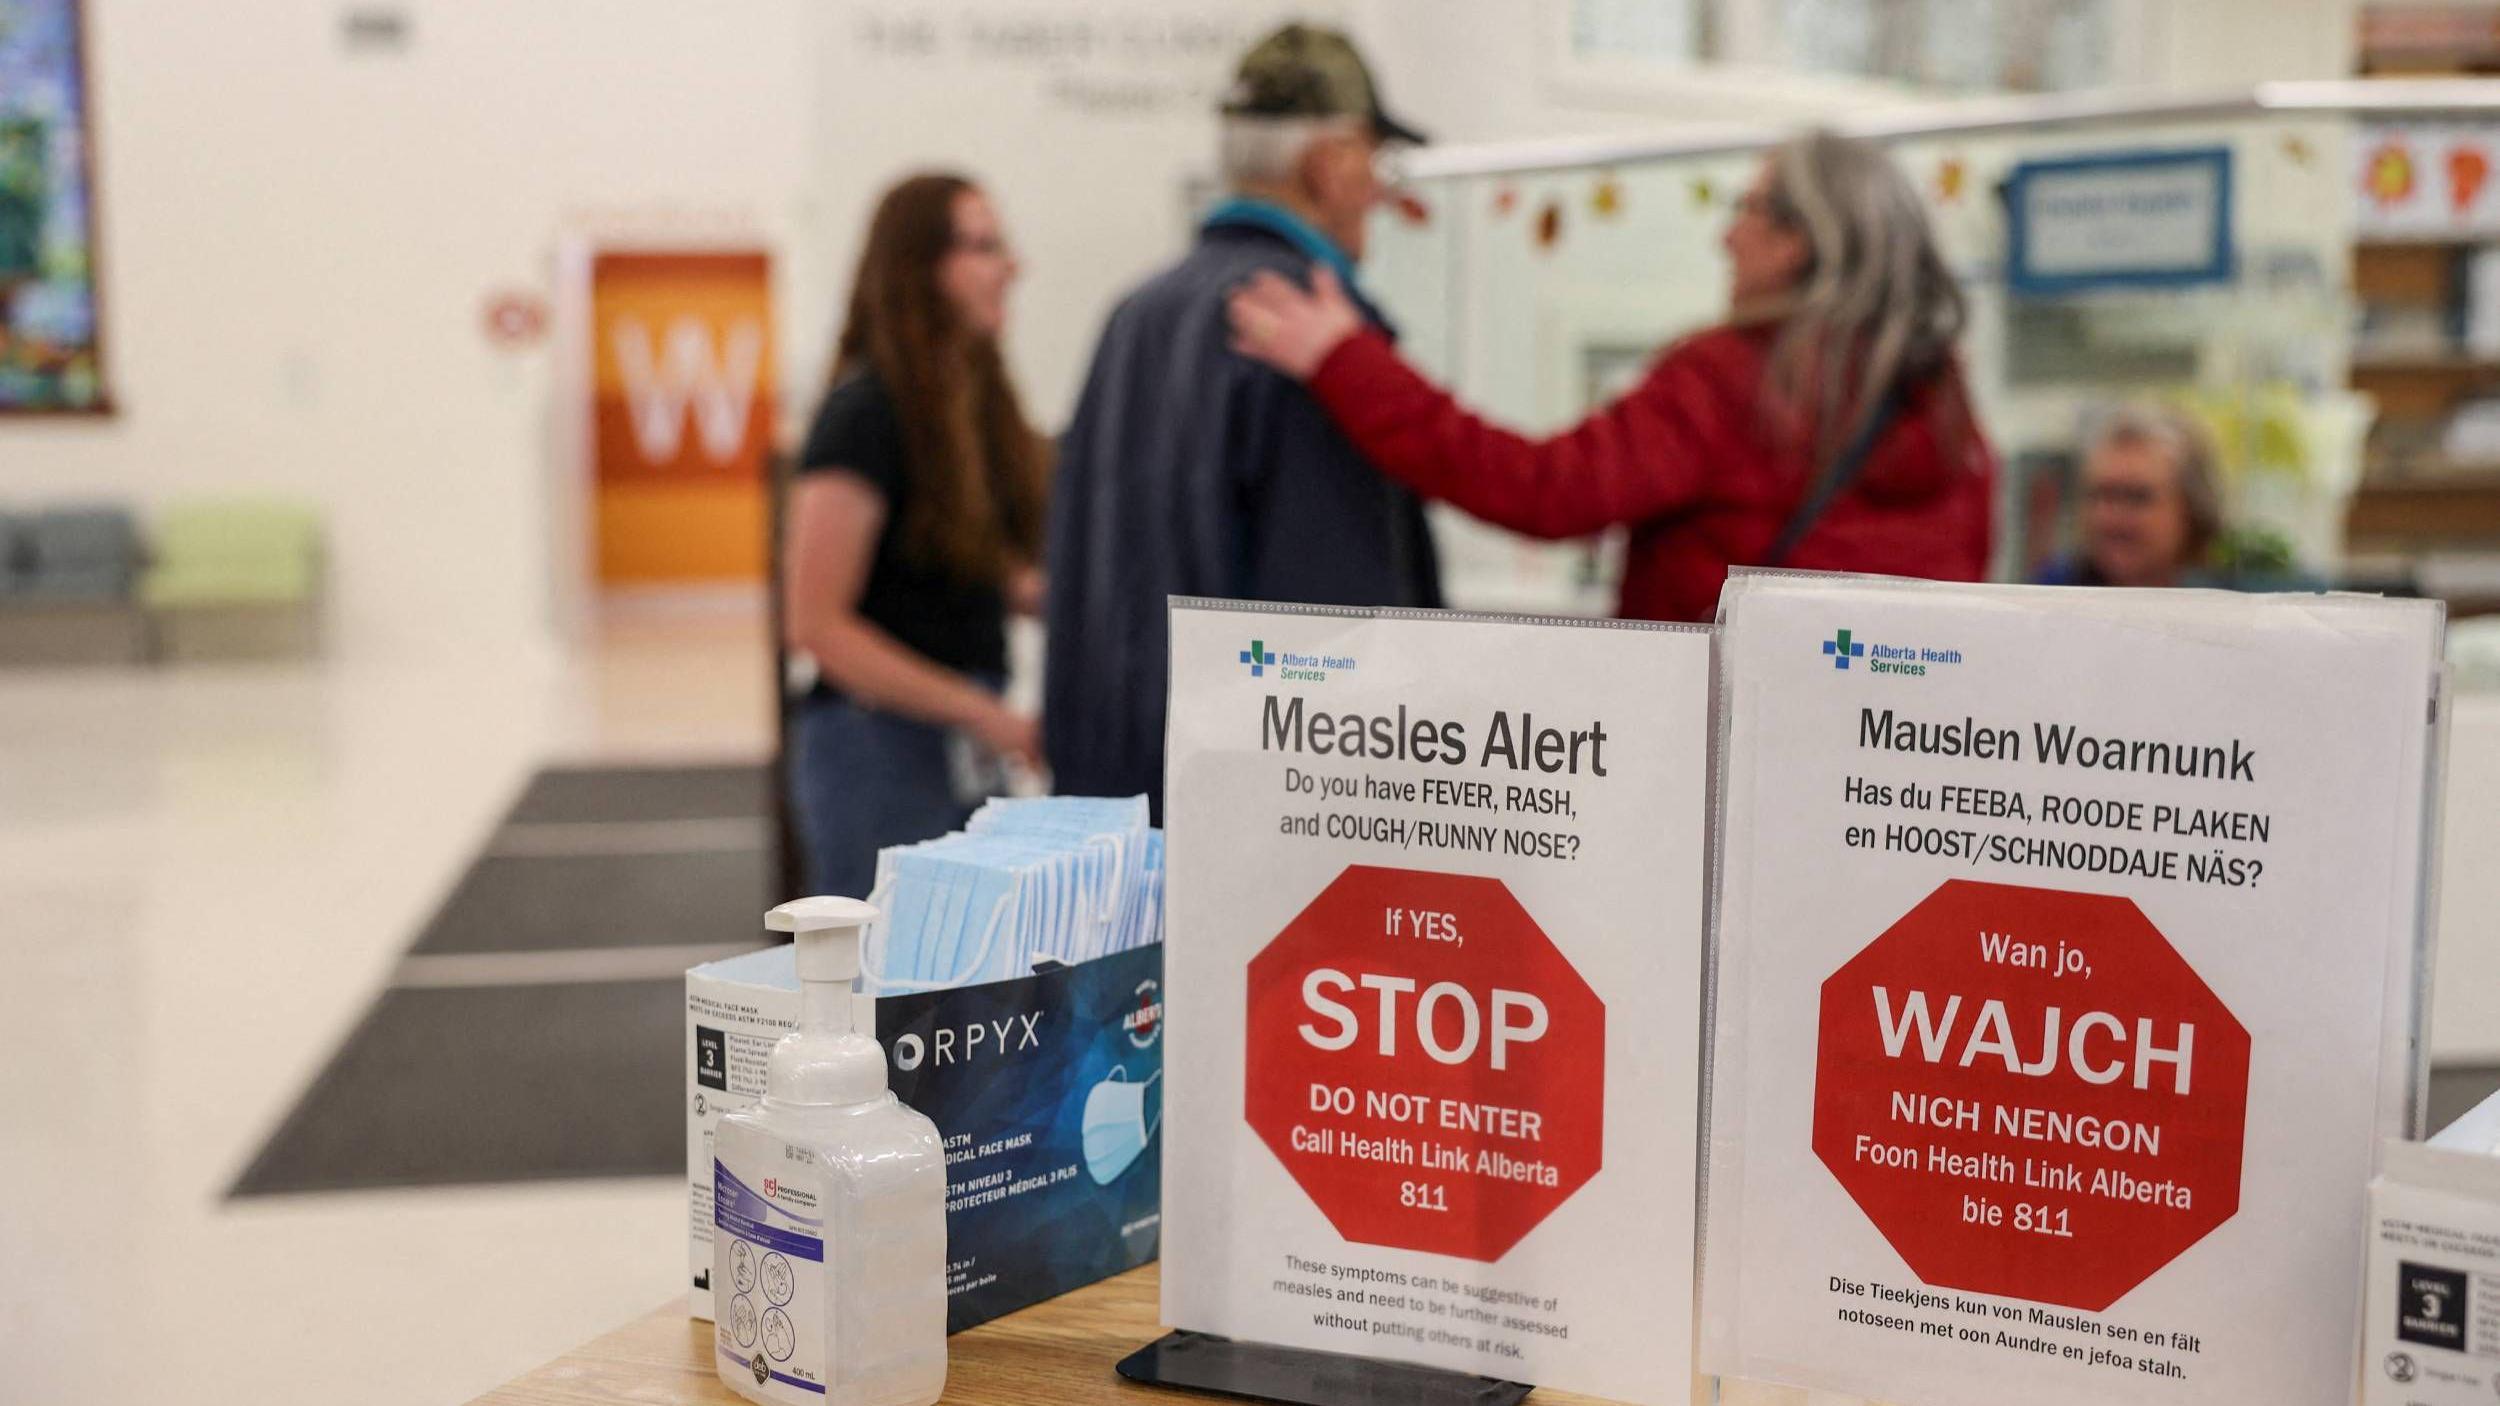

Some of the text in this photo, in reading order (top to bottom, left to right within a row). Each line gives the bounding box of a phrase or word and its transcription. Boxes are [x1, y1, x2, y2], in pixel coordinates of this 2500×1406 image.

[611, 312, 762, 464] W
[1281, 667, 1325, 681] Services
[1282, 653, 1355, 669] Alberta Health
[1871, 645, 1961, 663] Alberta Health
[1871, 659, 1925, 675] Services
[1263, 696, 1606, 777] Measles Alert
[1860, 708, 2255, 781] Mauslen Woarnunk
[1286, 768, 1576, 820] Do you have FEVER, RASH,
[1845, 777, 2269, 842] Has du FEEBA, ROODE PLAKEN
[1281, 813, 1580, 860] and COUGH/RUNNY NOSE?
[1846, 824, 2262, 887] en HOOST/SCHNODDAJE NÄS?
[1386, 908, 1463, 947] If YES,
[1980, 932, 2091, 979] Wan jo,
[724, 1002, 738, 1012] FACE
[741, 1005, 759, 1015] MASK
[738, 1015, 755, 1024] ASTM
[778, 1019, 793, 1029] REQ
[1299, 969, 1548, 1070] STOP
[701, 1039, 718, 1050] LEVEL
[705, 1049, 714, 1067] 3
[1872, 986, 2194, 1095] WAJCH
[700, 1066, 722, 1079] BARRIER
[1311, 1084, 1541, 1141] DO NOT ENTER
[1892, 1091, 2159, 1156] NICH NENGON
[943, 1133, 971, 1150] ASTM
[945, 1132, 1032, 1166] DICAL FACE MASK
[1292, 1125, 1558, 1186] Call Health Link Alberta
[945, 1169, 1012, 1198] STM NIVEAU 3
[1008, 1173, 1049, 1196] MÉDICAL
[1050, 1171, 1056, 1183] 3
[1057, 1164, 1078, 1180] PLIS
[1856, 1135, 2191, 1209] Foon Health Link Alberta
[777, 1186, 817, 1201] PROFESSIONAL
[1401, 1181, 1447, 1211] 811
[1963, 1195, 2072, 1237] bie 811
[1286, 1255, 1557, 1311] These symptoms can be suggestive of
[2411, 1279, 2449, 1296] LEVEL
[1274, 1281, 1567, 1339] measles and need to be further assessed
[1830, 1277, 2200, 1353] Dise Tieekjens kun von Mauslen sen en fält
[2421, 1293, 2441, 1319] 3
[1314, 1313, 1523, 1359] without putting others at risk.
[1839, 1309, 2186, 1379] notoseen met oon Aundre en jefoa staln.
[792, 1366, 815, 1380] 400 mL
